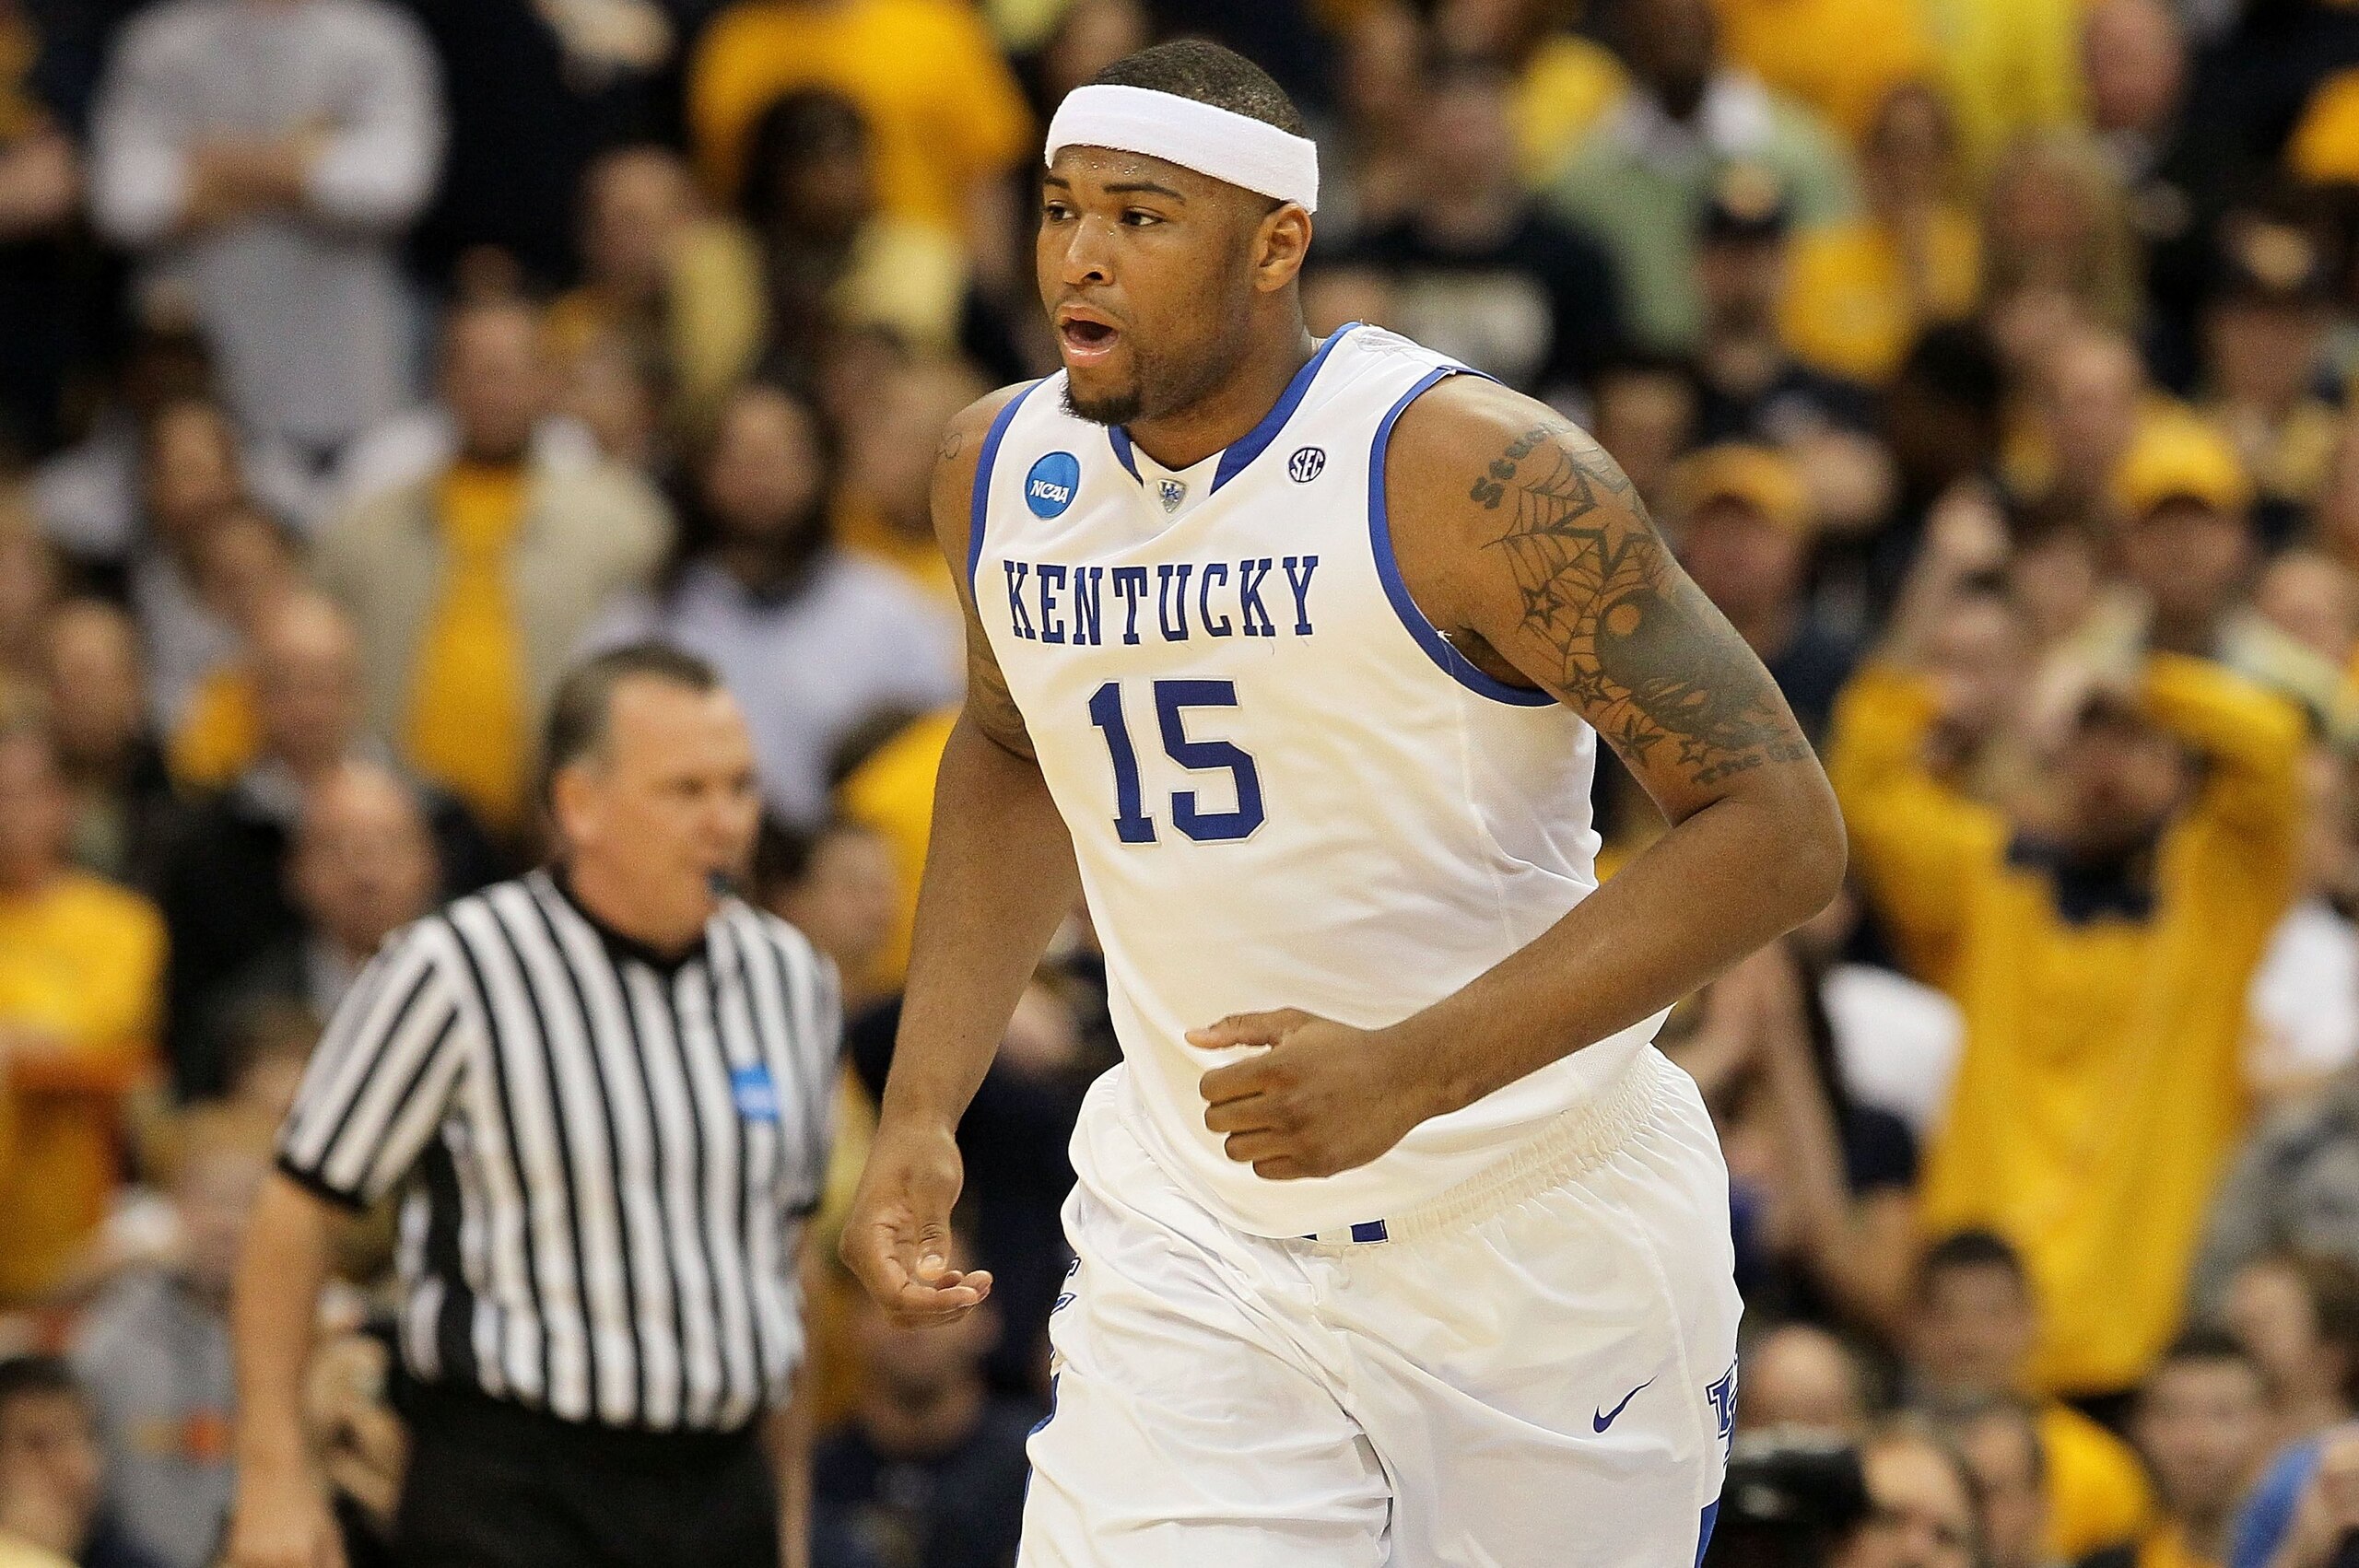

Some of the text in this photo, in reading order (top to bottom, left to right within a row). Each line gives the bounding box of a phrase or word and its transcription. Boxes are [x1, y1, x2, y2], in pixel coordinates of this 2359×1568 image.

[1030, 479, 1069, 504] NCAA
[1290, 449, 1324, 481] SEC
[1003, 556, 1319, 646] KENTUCKY
[1088, 679, 1266, 844] 15
